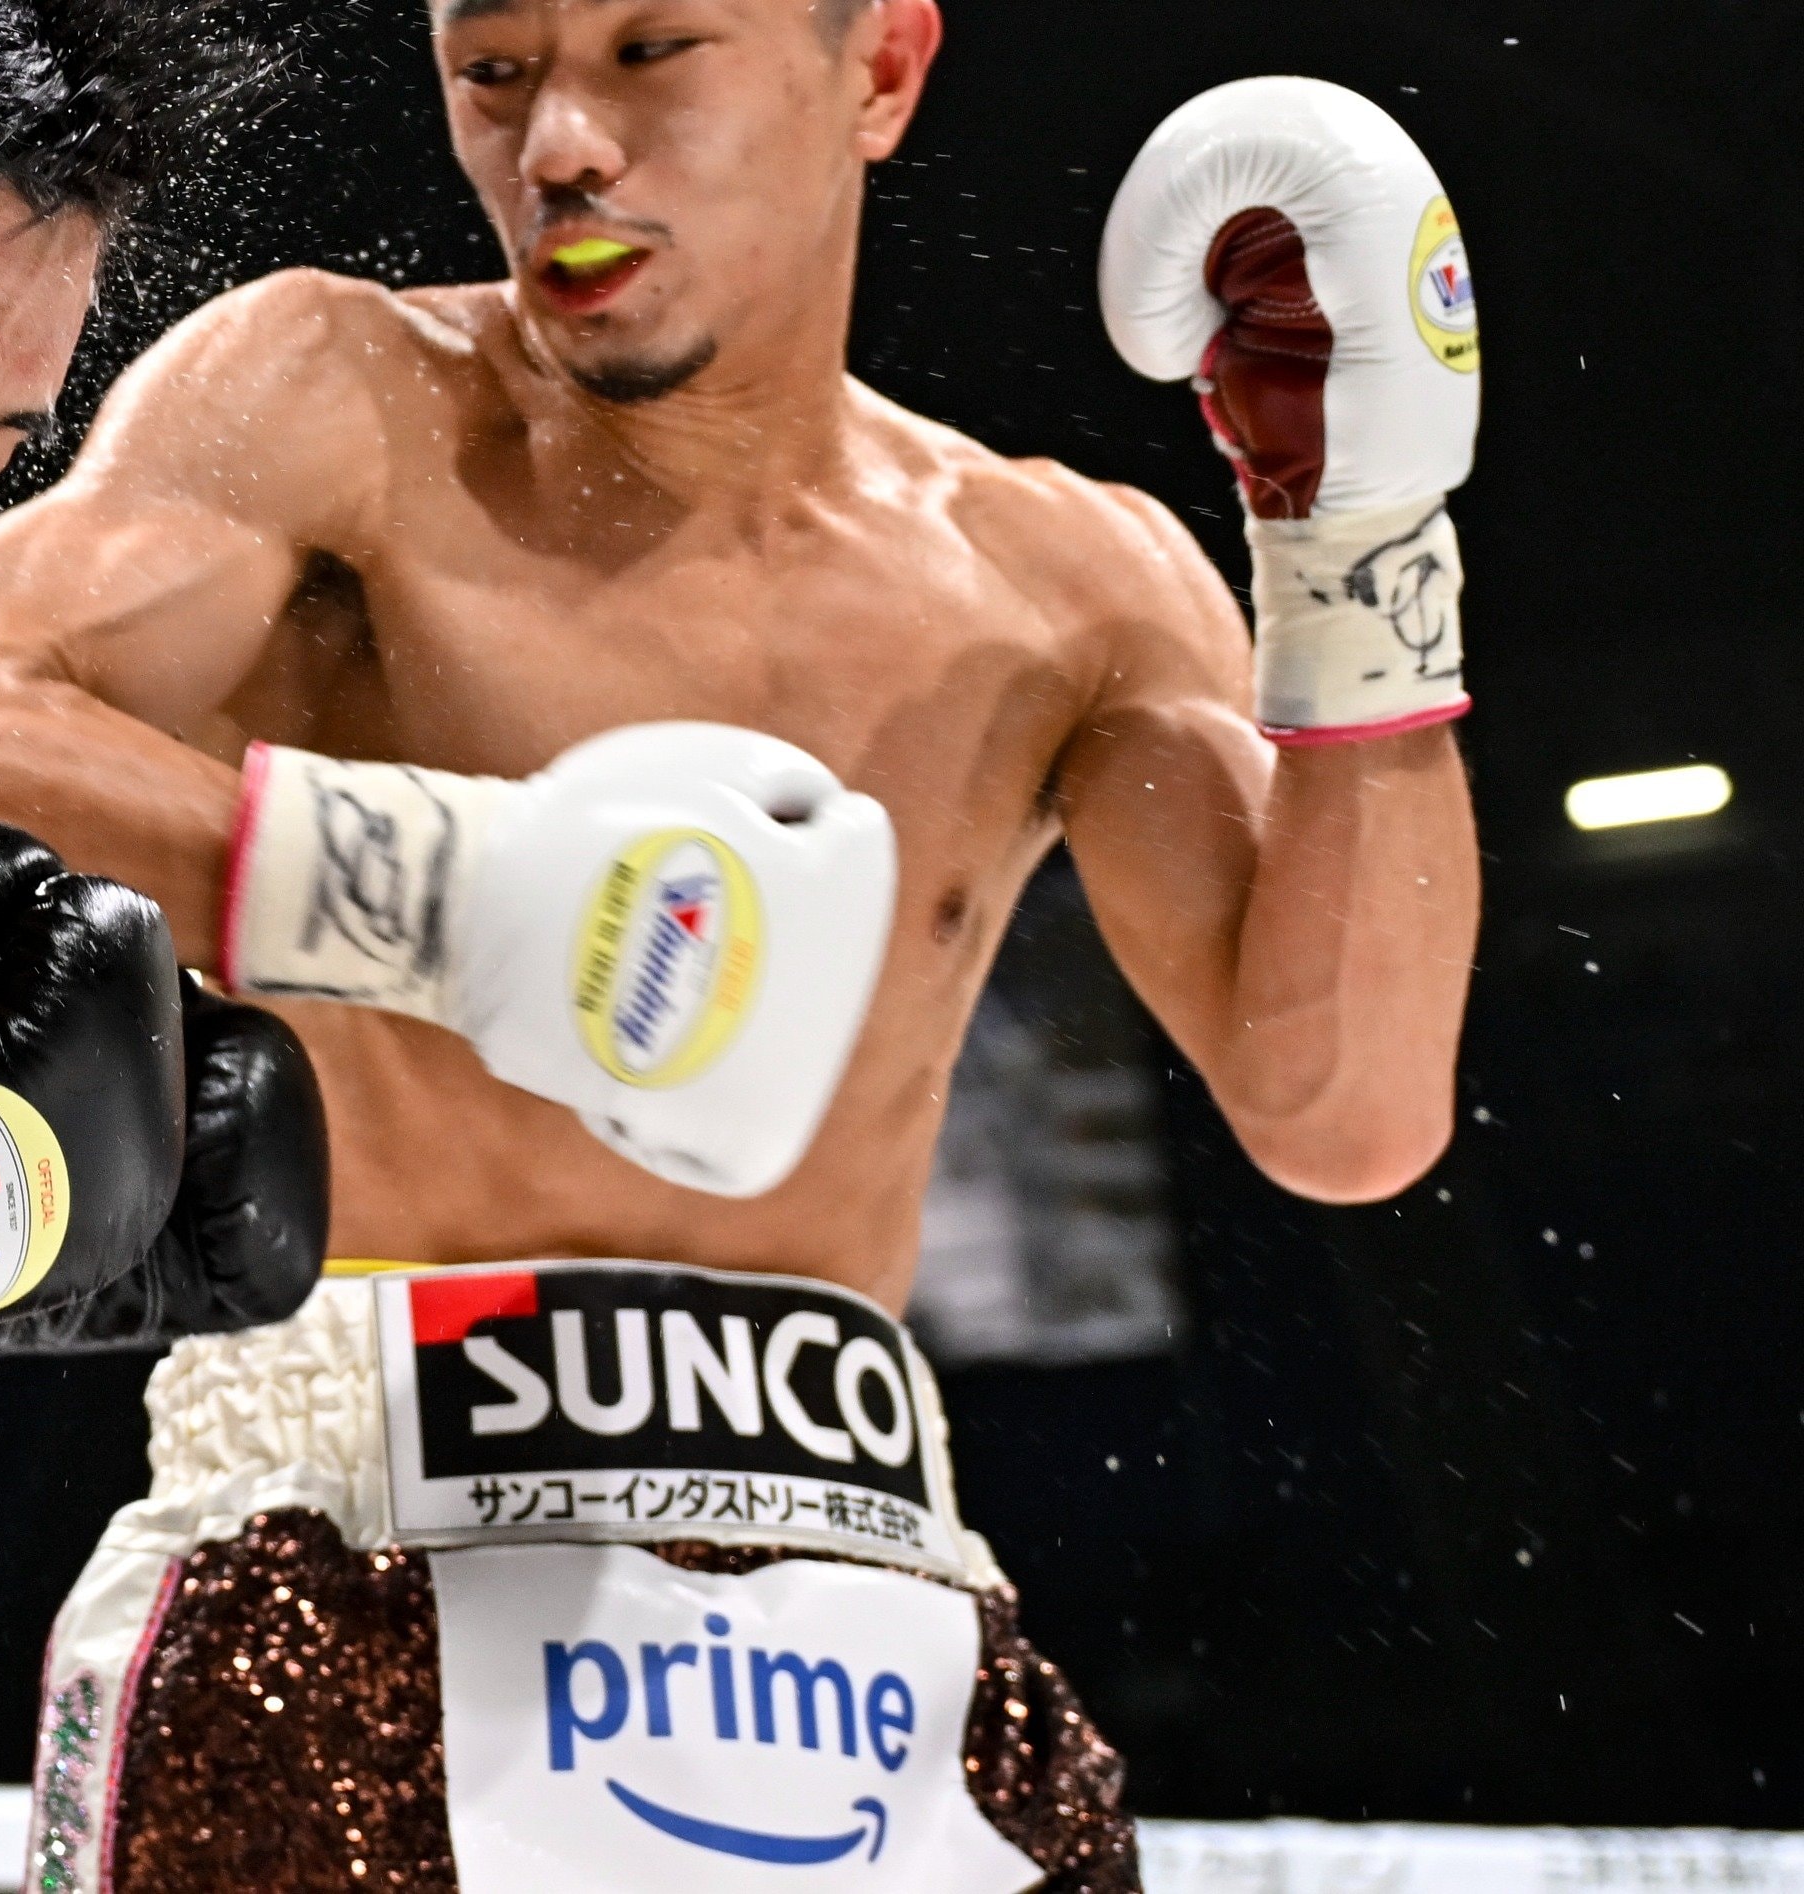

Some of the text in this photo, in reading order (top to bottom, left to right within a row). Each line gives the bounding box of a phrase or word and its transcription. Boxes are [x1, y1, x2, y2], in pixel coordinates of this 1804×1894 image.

[5, 1182, 17, 1212] SINCE
[37, 1157, 56, 1230] OFFICIAL
[462, 1308, 914, 1467] SUNCO
[467, 1473, 925, 1548] サンコーインダストリー株式会社
[542, 1612, 916, 1772] prime
